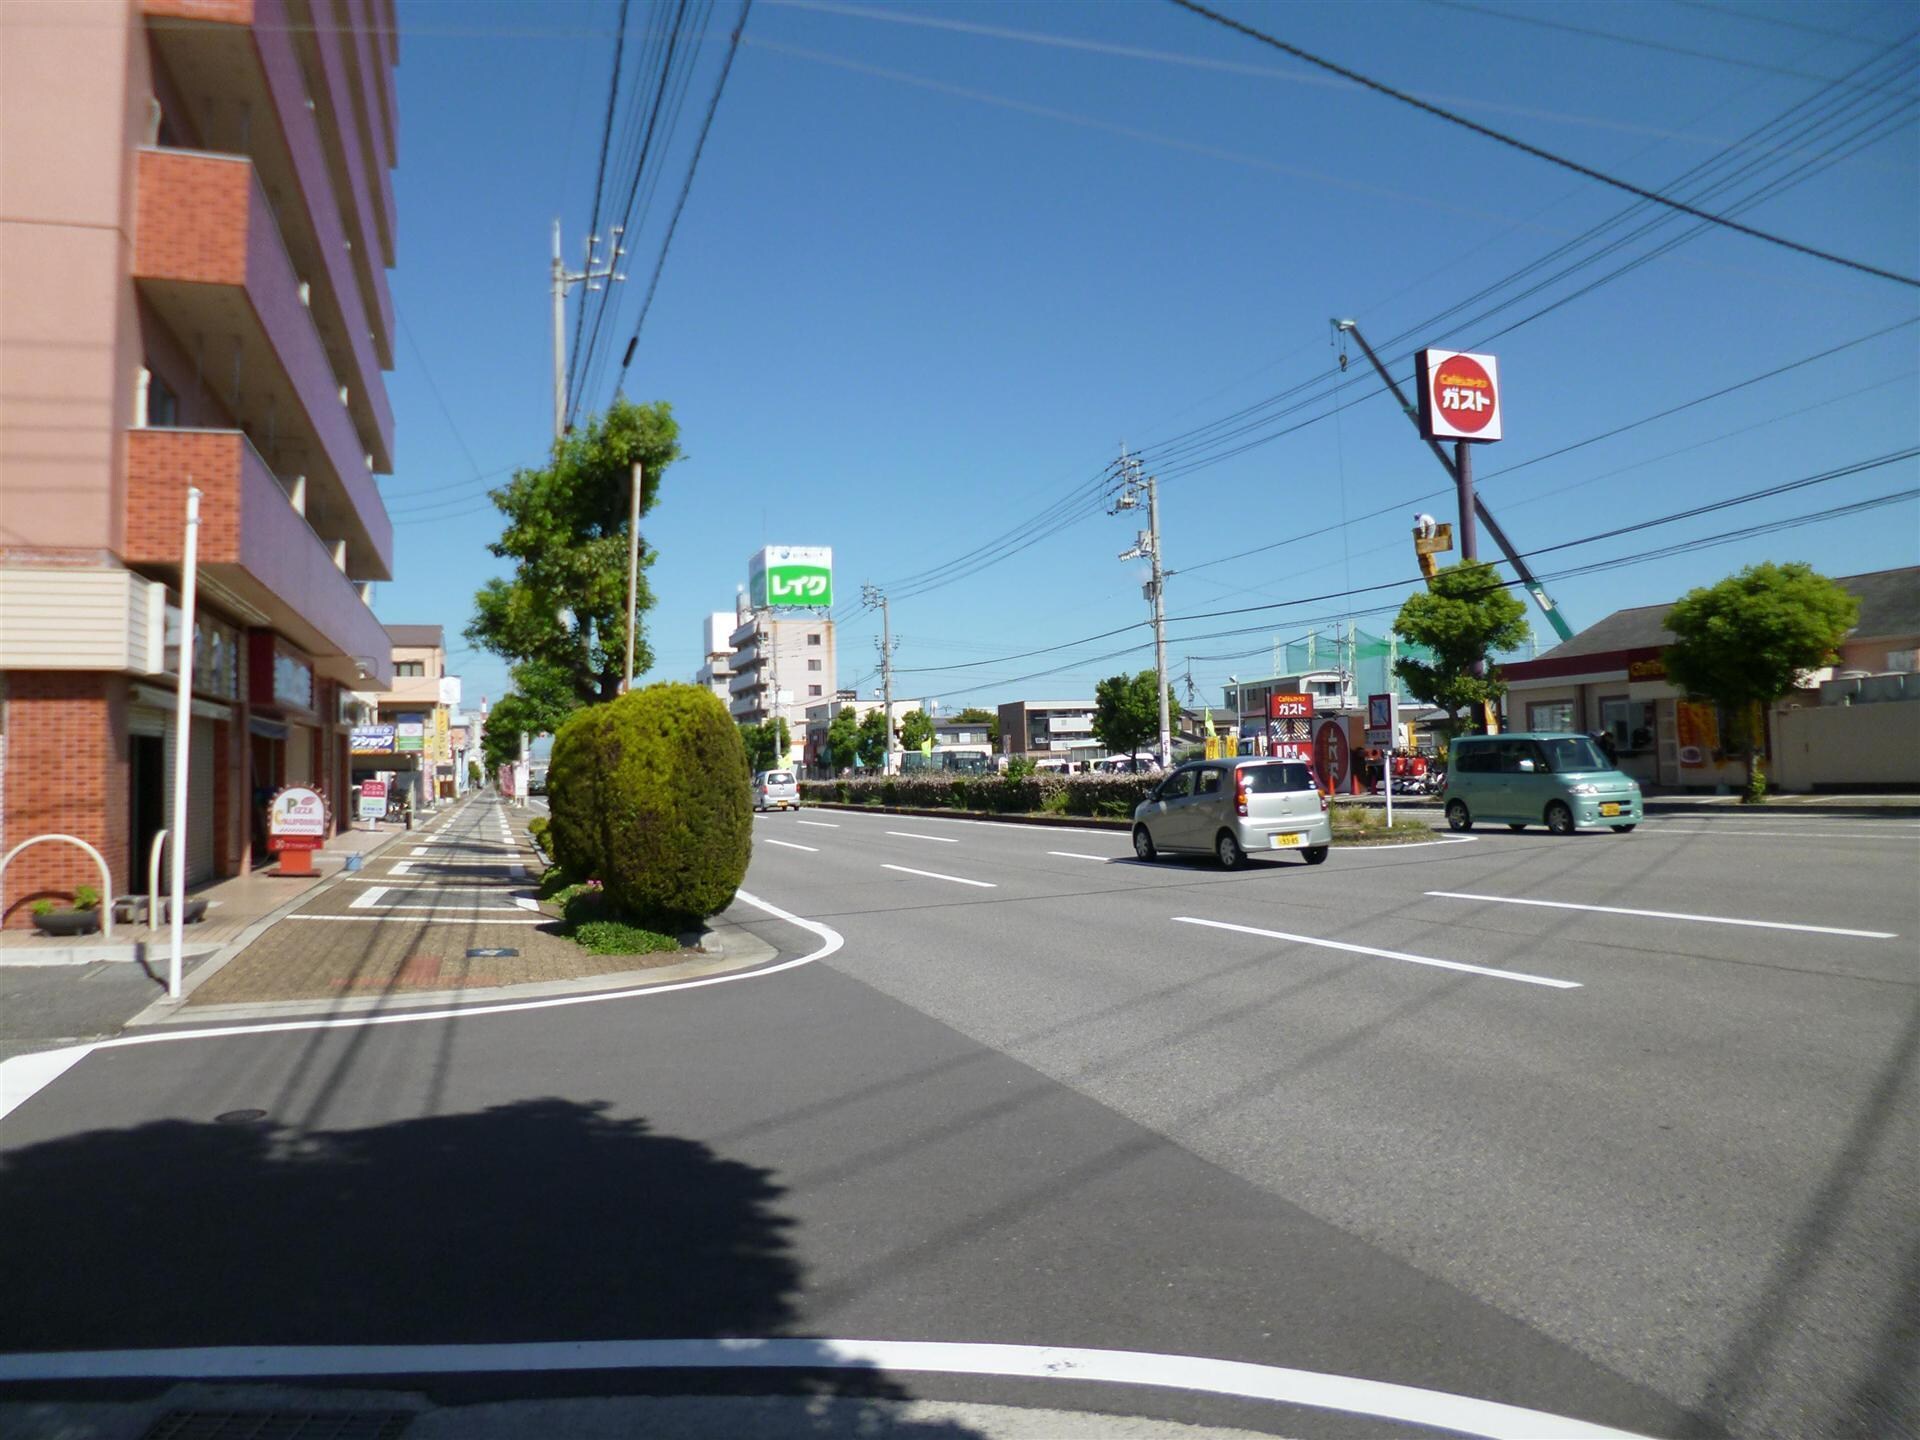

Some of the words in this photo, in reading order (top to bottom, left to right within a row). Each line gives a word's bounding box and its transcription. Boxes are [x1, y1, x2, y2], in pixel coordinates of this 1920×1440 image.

[1442, 387, 1491, 412] ガスト
[772, 574, 827, 597] レイク
[1279, 703, 1307, 716] ガスト
[1277, 745, 1298, 759] IN
